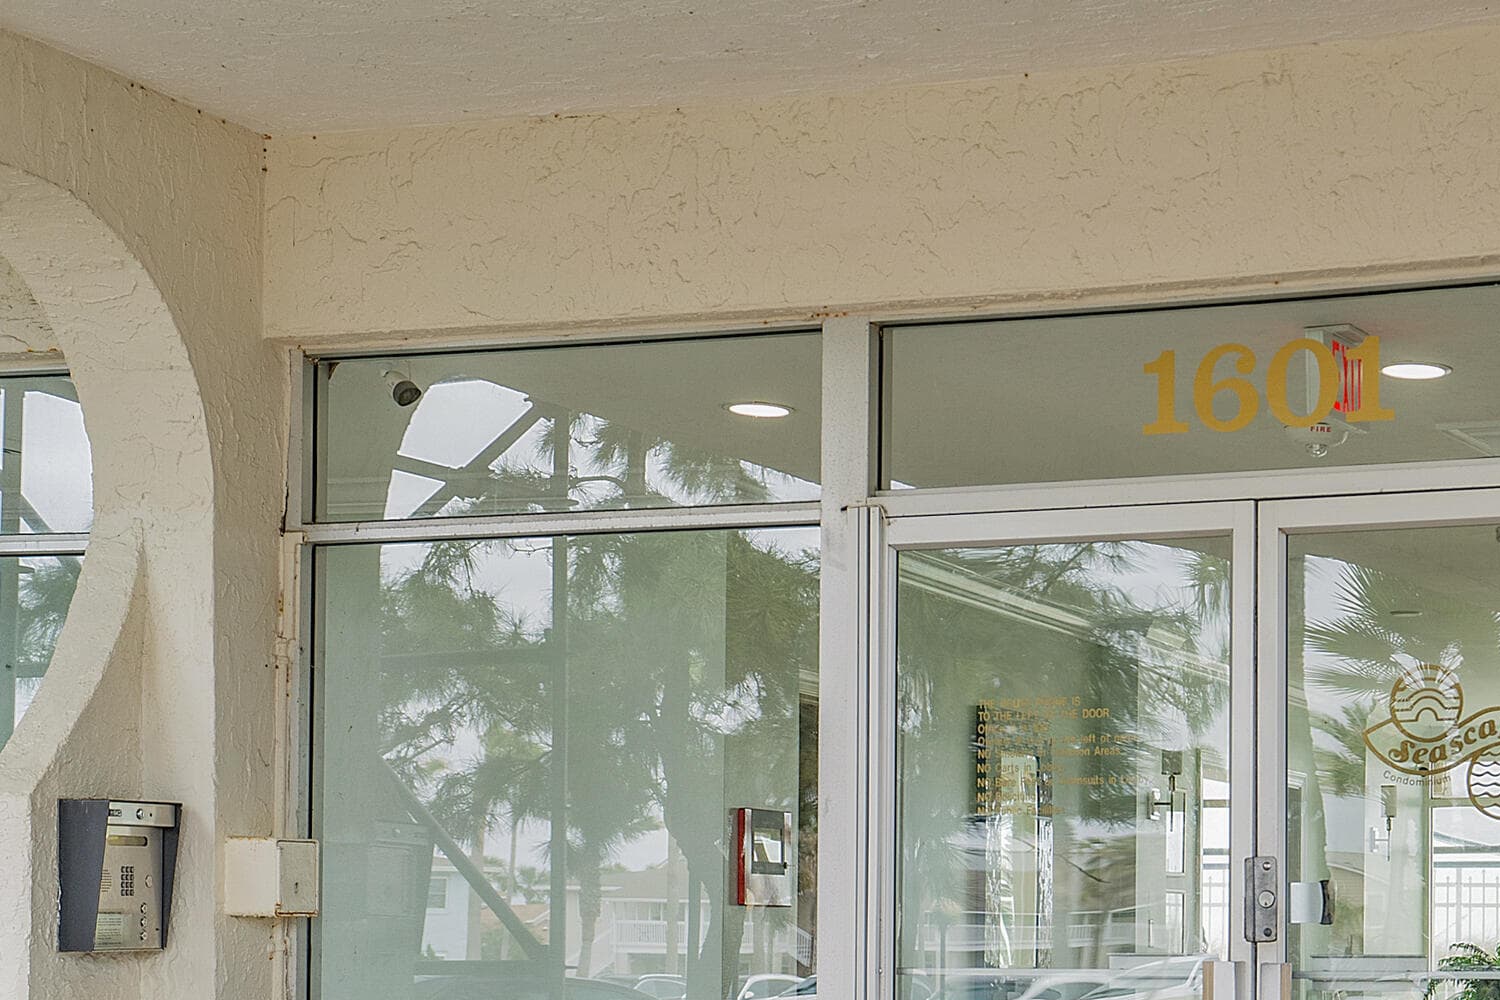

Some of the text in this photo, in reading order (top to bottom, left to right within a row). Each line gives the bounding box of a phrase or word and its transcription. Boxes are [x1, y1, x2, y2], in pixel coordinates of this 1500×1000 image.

[1142, 335, 1395, 435] 1601
[1310, 425, 1332, 434] FIRE
[1072, 696, 1080, 706] IS
[978, 711, 991, 721] TO
[994, 711, 1012, 721] THE
[1082, 708, 1110, 719] DOOR
[977, 749, 991, 760] NO
[1094, 745, 1121, 756] Areas
[977, 763, 992, 774] NO
[977, 777, 992, 788] NO
[1382, 770, 1452, 788] Condominium
[977, 791, 992, 803] NO
